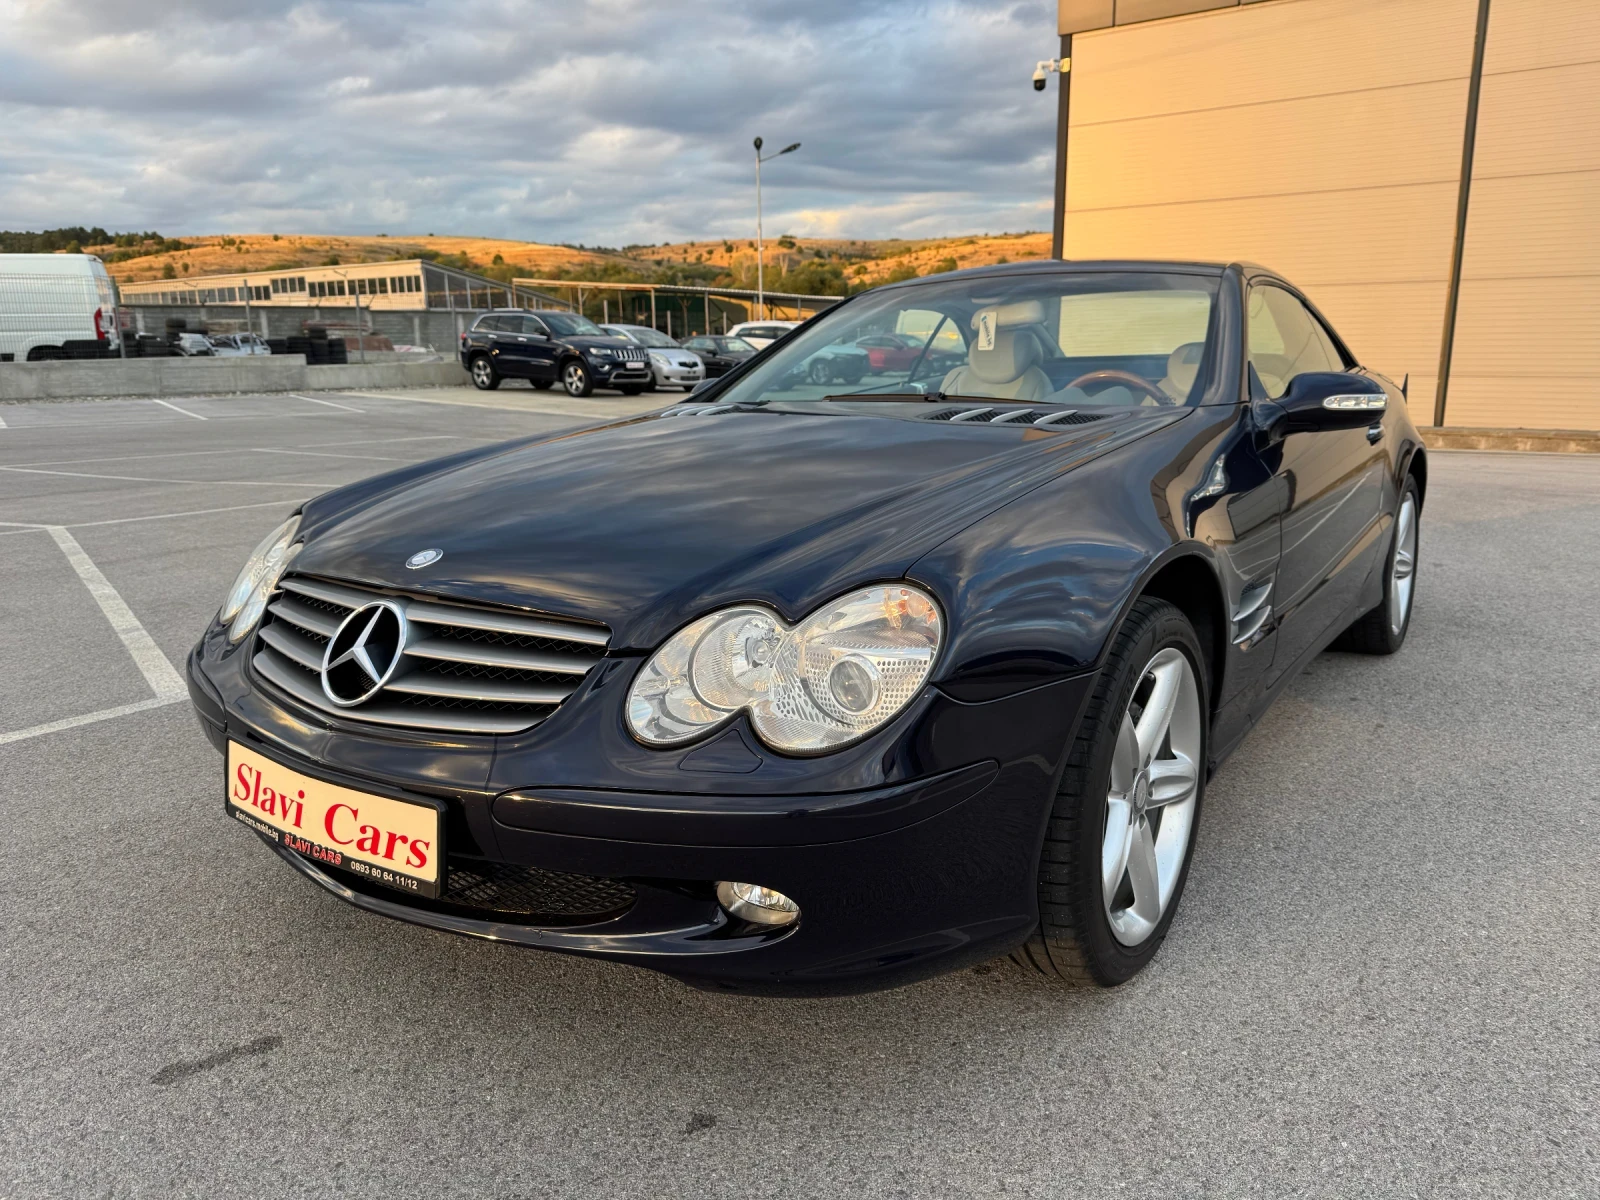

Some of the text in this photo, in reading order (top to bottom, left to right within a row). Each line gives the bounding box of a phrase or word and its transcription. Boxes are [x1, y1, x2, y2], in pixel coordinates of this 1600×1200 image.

[233, 763, 430, 869] Slavi Cars
[284, 833, 342, 865] SLAVI CARS
[371, 867, 381, 878] 60
[383, 872, 394, 882] 64
[395, 875, 418, 890] 11/12
